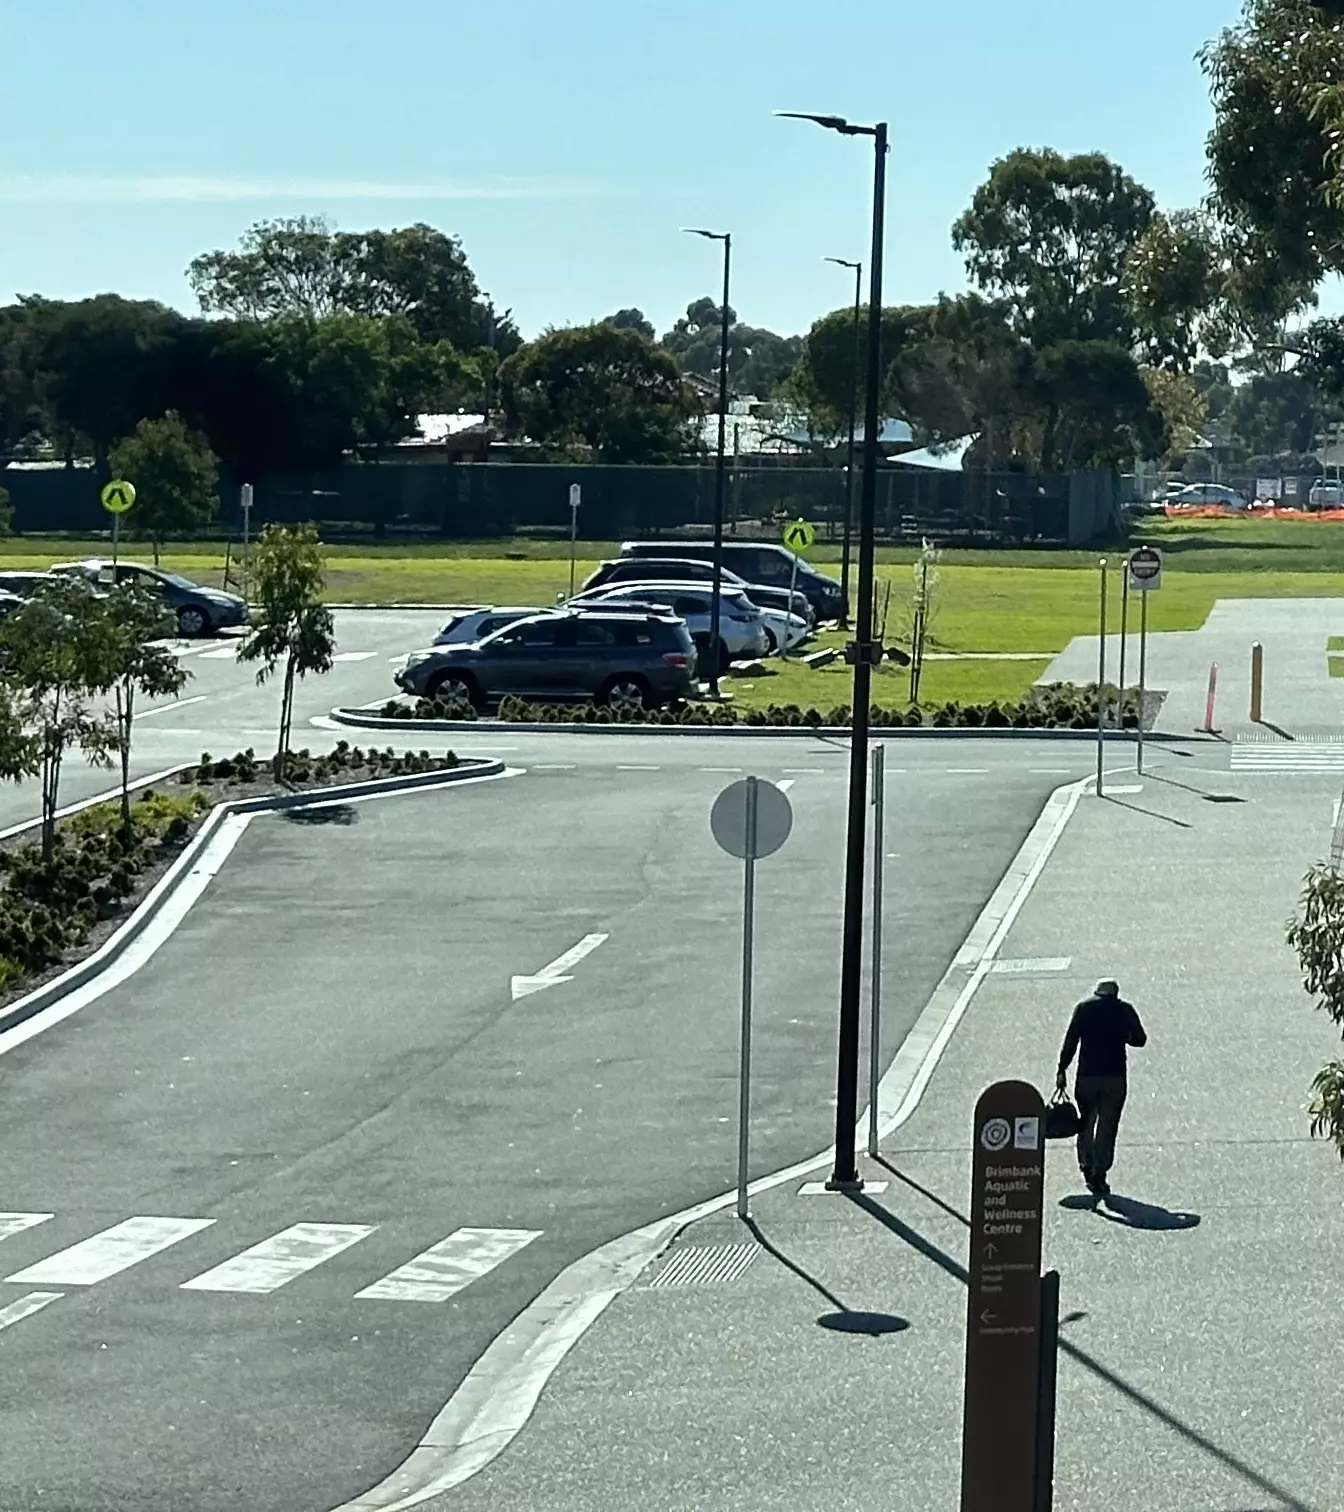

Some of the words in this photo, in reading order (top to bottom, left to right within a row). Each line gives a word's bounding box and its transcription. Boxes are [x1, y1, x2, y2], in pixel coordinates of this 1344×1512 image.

[985, 1165, 1041, 1178] Brimbank
[984, 1179, 1030, 1194] Aquatic
[984, 1194, 1006, 1206] and
[984, 1208, 1037, 1220] Wellness
[983, 1223, 1023, 1235] Centre
